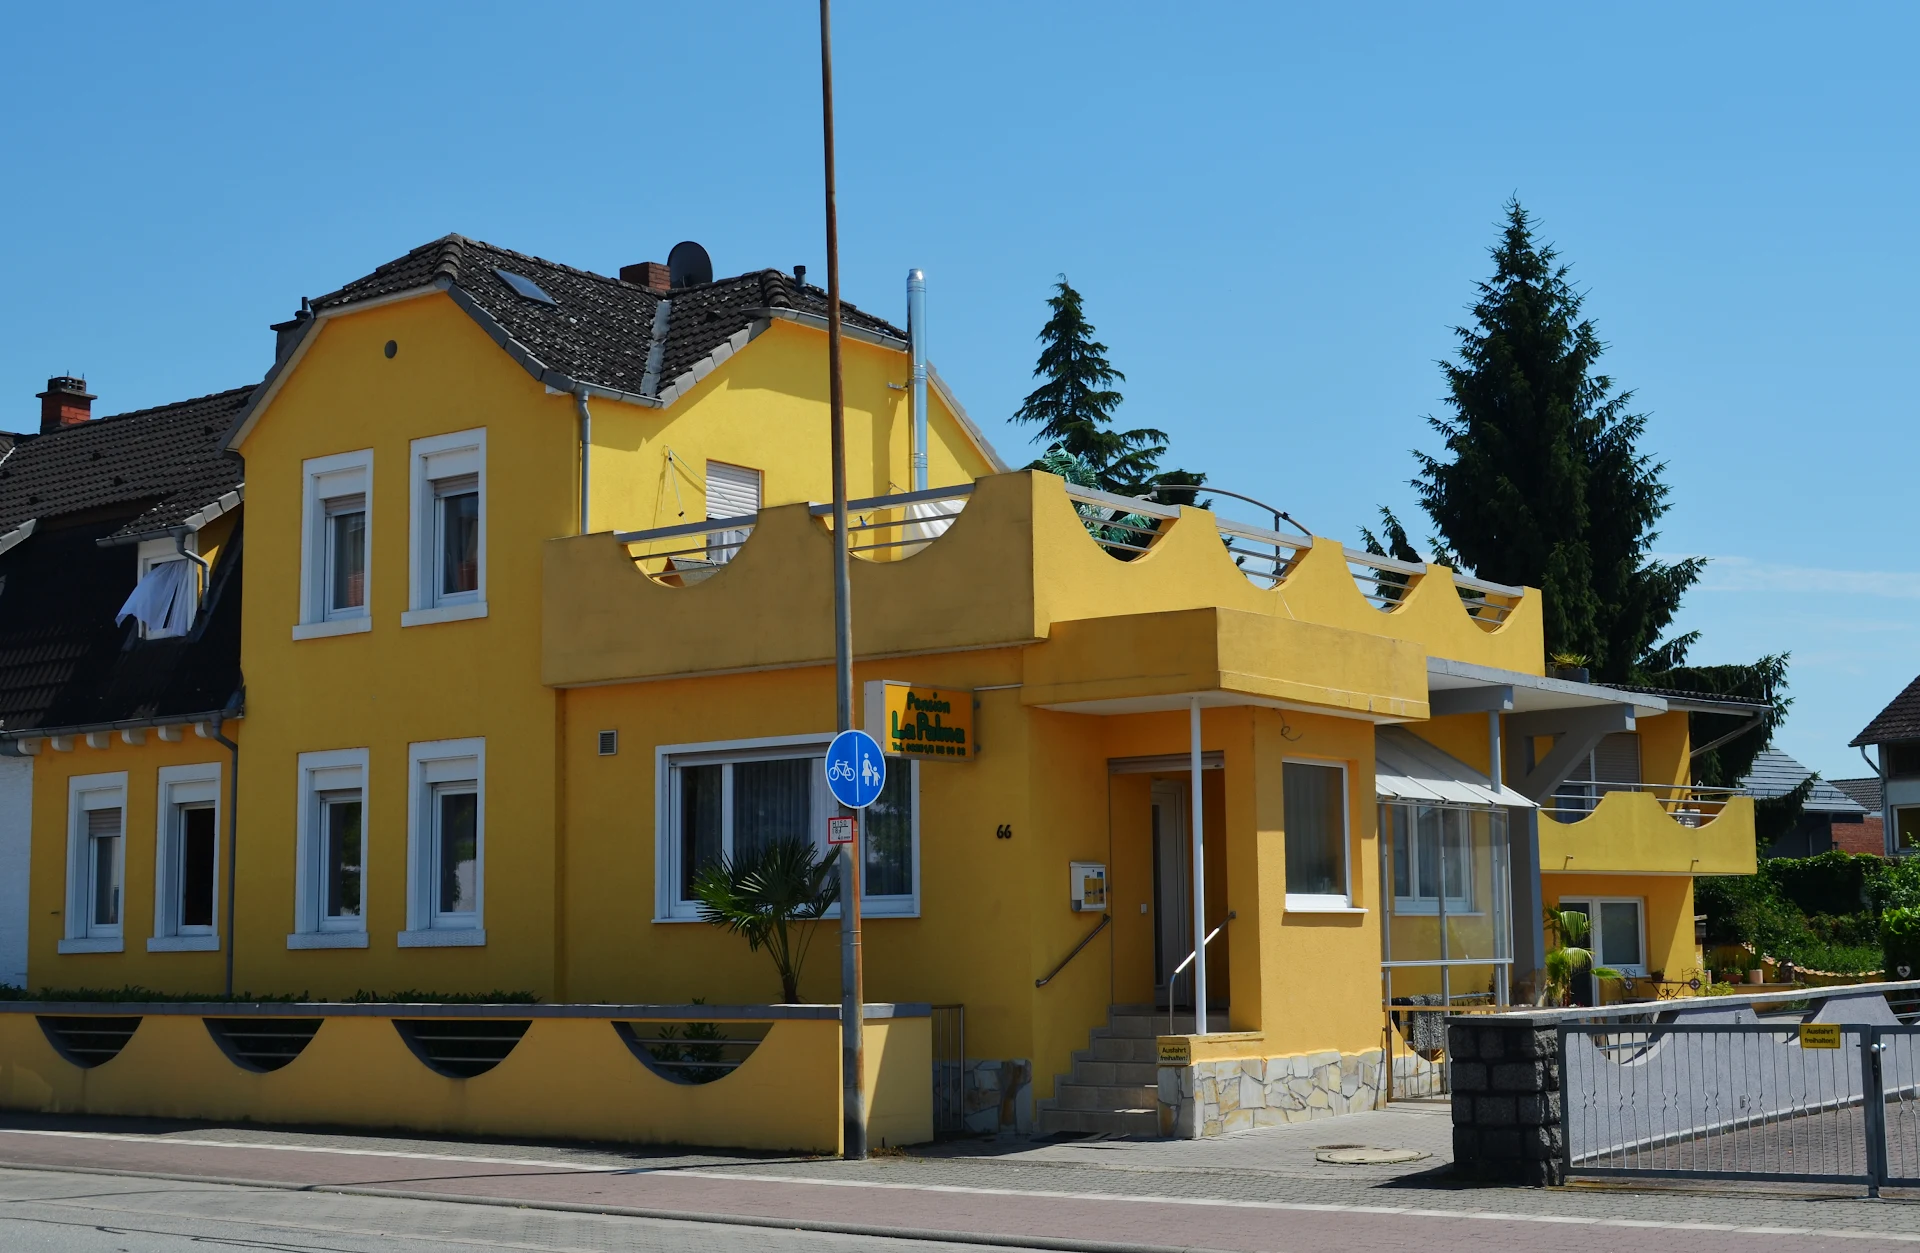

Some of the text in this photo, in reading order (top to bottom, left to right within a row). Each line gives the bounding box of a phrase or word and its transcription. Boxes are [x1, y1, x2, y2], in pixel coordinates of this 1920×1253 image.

[907, 691, 950, 714] Pension
[892, 710, 965, 744] La Palma
[891, 741, 905, 752] Tel.
[996, 824, 1012, 839] 66
